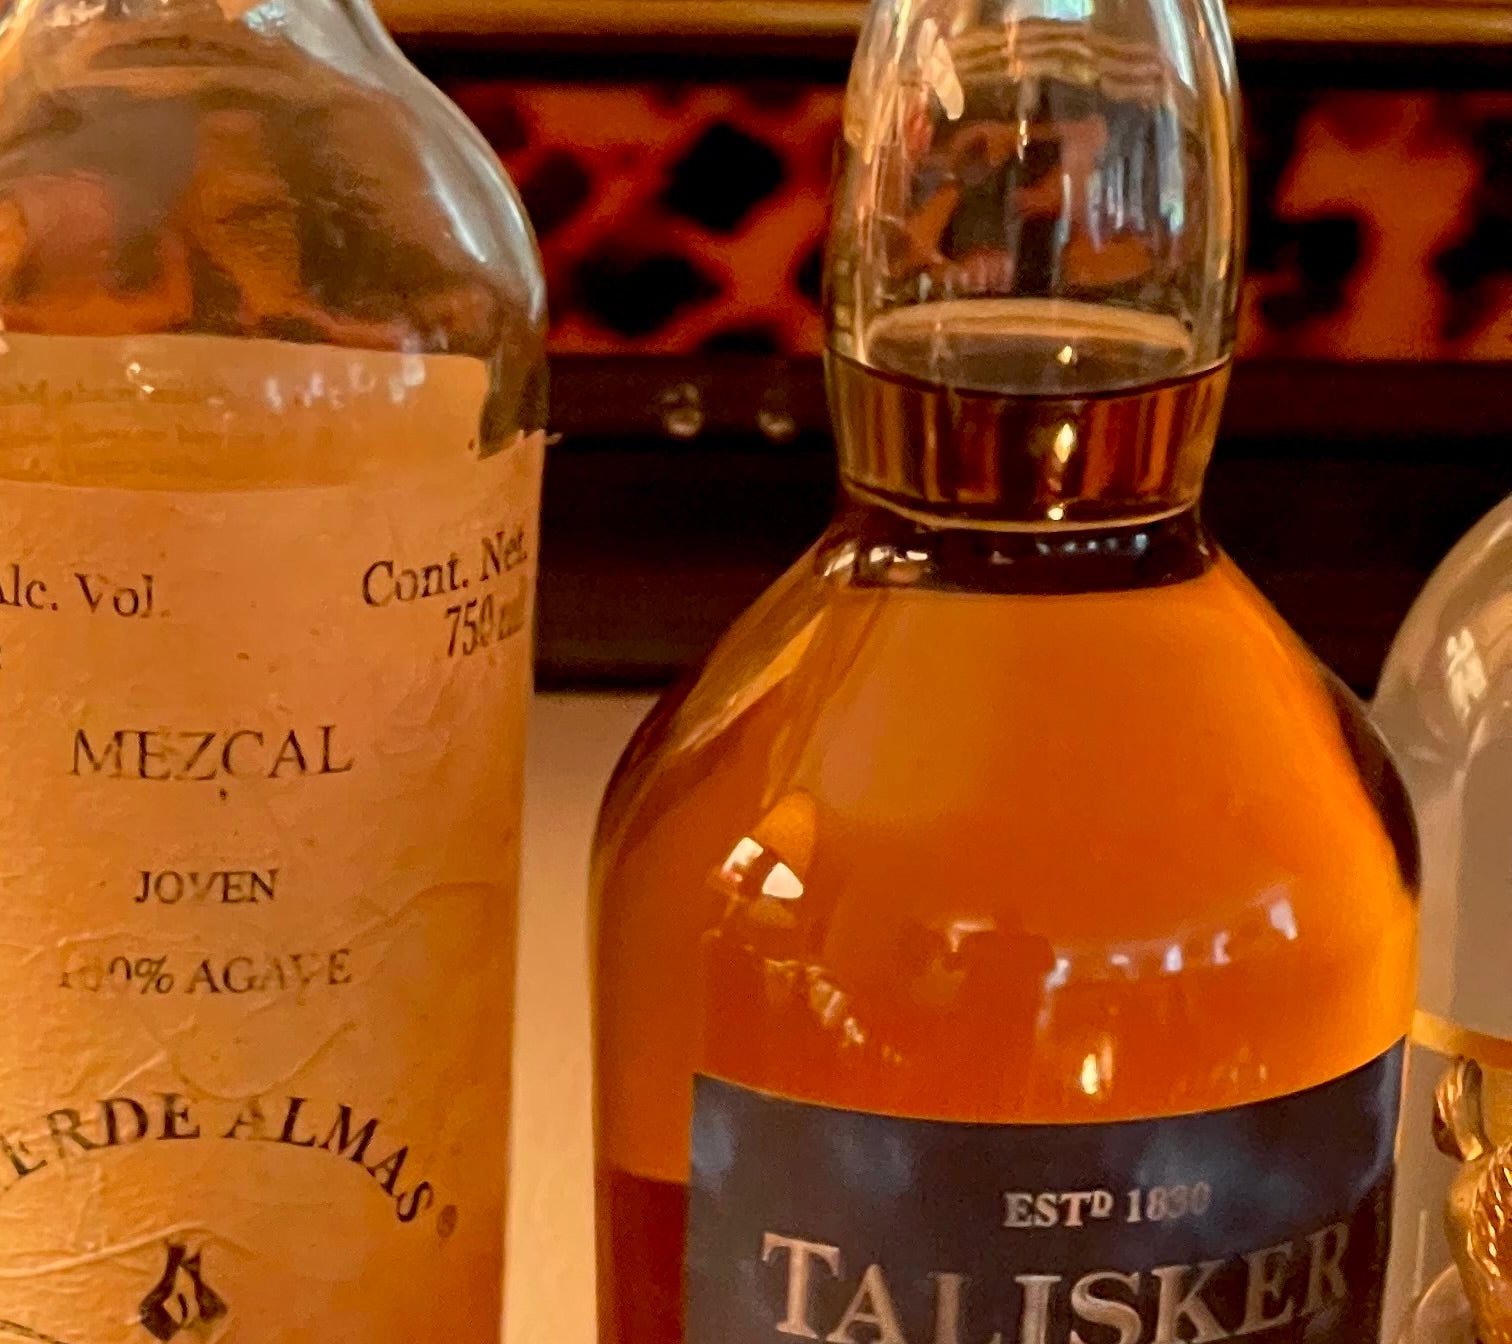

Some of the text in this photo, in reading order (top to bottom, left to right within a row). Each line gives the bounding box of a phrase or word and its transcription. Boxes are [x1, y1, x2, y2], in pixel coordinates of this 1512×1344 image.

[361, 552, 470, 608] Cont.
[443, 593, 495, 658] 750
[67, 723, 356, 782] MEZCAL
[133, 868, 283, 905] JOVEN
[183, 948, 355, 998] AGAVE
[220, 1095, 436, 1225] ALMAS
[1125, 1180, 1214, 1225] 1830
